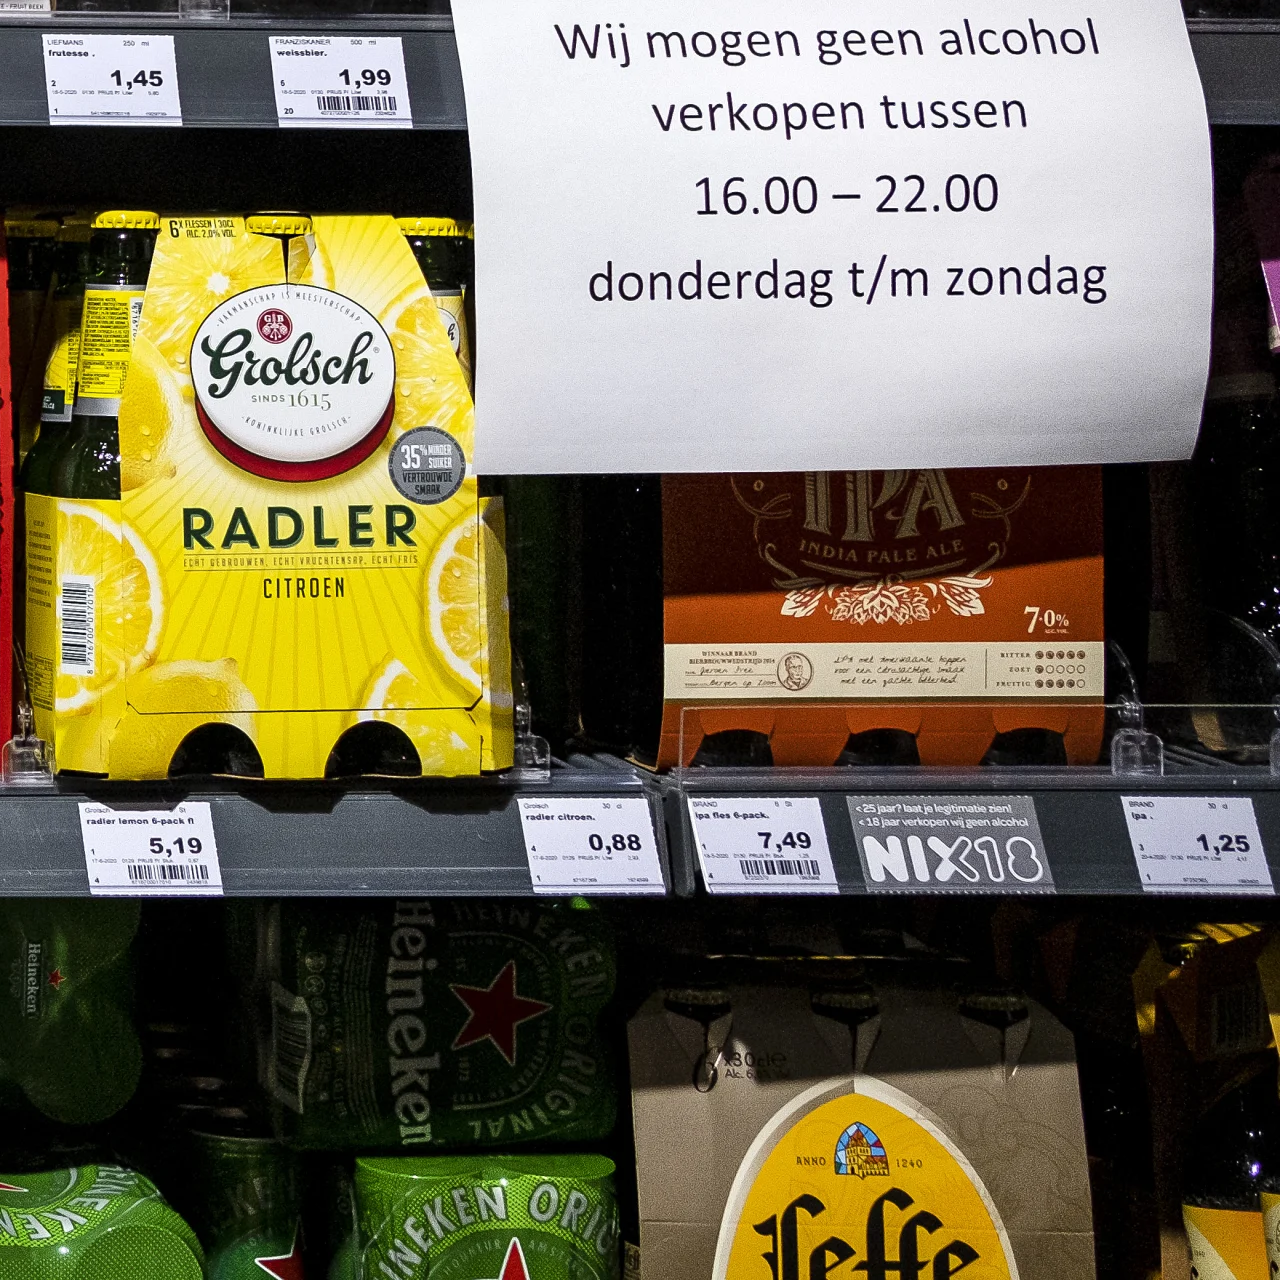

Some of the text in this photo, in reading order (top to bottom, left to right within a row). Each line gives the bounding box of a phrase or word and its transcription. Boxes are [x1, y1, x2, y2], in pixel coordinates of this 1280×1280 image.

[277, 49, 327, 58] weissbier.
[555, 17, 1099, 69] Wij mogen geen alcohol
[110, 70, 163, 89] 1,45
[339, 69, 391, 89] 1,99
[653, 94, 1027, 139] verkopen tussen
[695, 173, 999, 217] 16.00 22.00
[589, 255, 1107, 309] donderdag t/m zondag
[201, 323, 374, 400] Grolsch
[252, 390, 331, 412] SINDS 1615
[402, 471, 453, 483] VERTROUWDE
[183, 504, 417, 550] RADLER
[799, 539, 964, 564] INDIA PALE ALE
[263, 578, 345, 599] CITROEN
[150, 837, 202, 857] 5,19
[589, 834, 641, 854] 0,88
[757, 831, 812, 852] 7,49
[1196, 834, 1250, 854] 1,25
[862, 836, 1043, 882] NIX18
[796, 1156, 923, 1169] ANNO 1240
